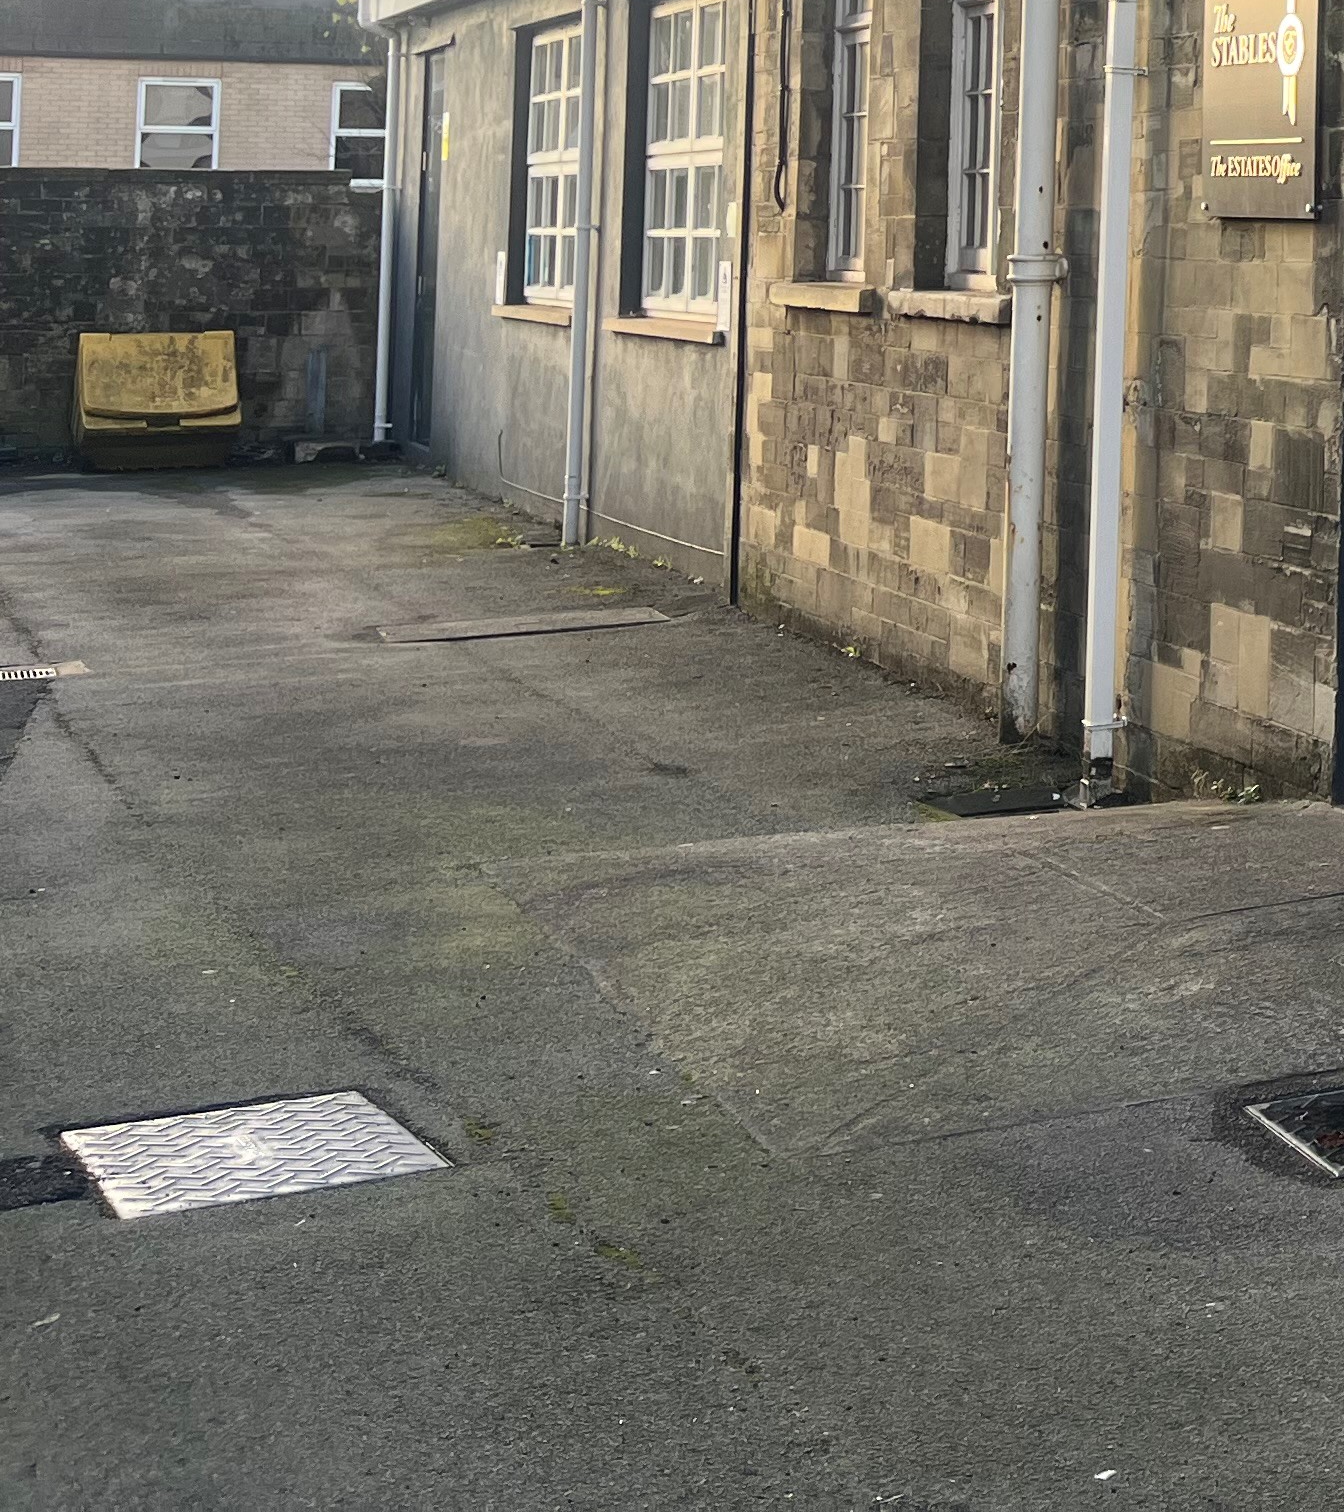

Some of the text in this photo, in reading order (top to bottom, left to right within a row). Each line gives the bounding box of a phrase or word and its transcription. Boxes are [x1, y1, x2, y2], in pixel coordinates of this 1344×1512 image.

[1213, 3, 1236, 33] The
[1211, 31, 1278, 68] STABLES
[1210, 155, 1228, 177] The
